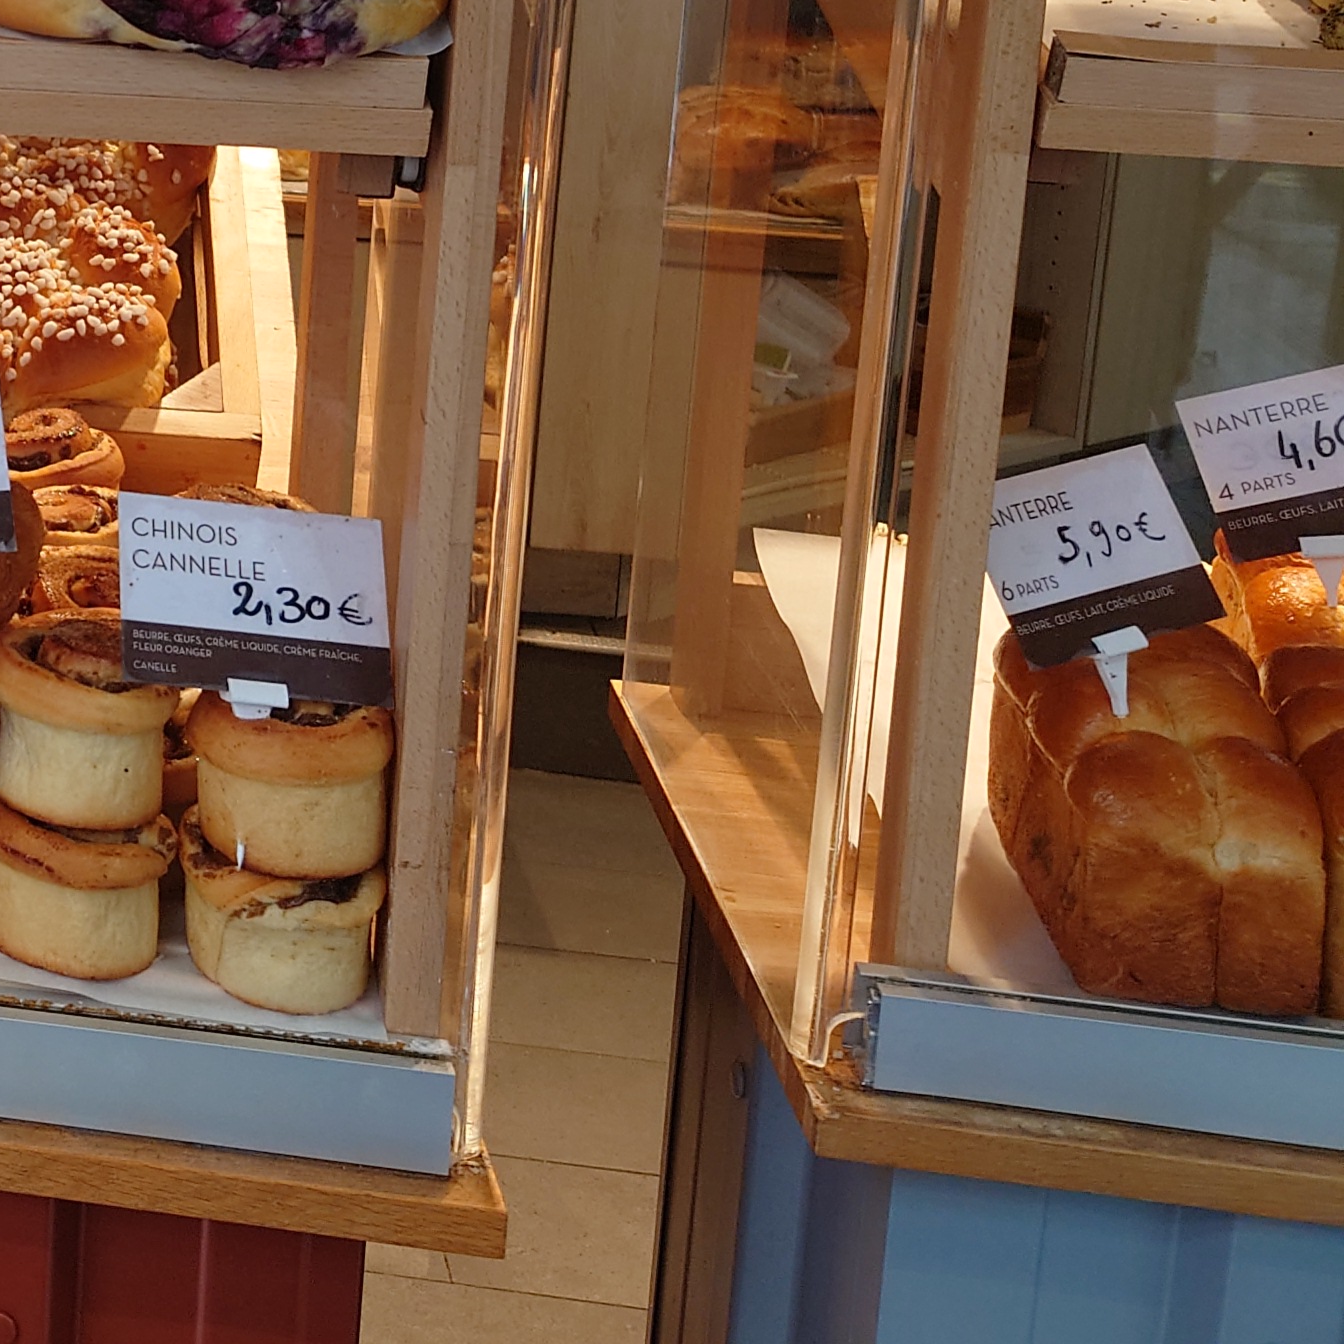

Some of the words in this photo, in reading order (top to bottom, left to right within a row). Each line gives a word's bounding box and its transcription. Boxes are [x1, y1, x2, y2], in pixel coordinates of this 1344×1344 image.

[1193, 392, 1329, 438] NANTERRE
[1219, 483, 1234, 500] 4
[1241, 472, 1296, 495] PARTS
[989, 491, 1074, 531] ANTERRE
[131, 516, 238, 547] CHINOIS
[1057, 511, 1166, 568] 5,90€
[131, 548, 266, 582] CANNELLE
[232, 581, 373, 626] 2,30€
[1001, 580, 1015, 602] 6
[1017, 575, 1060, 597] PARTS
[133, 641, 162, 653] FLEUR
[164, 644, 213, 658] ORANGER
[205, 635, 239, 650] CRÈME
[283, 644, 317, 659] CRÈME
[133, 659, 177, 673] CANELLE
